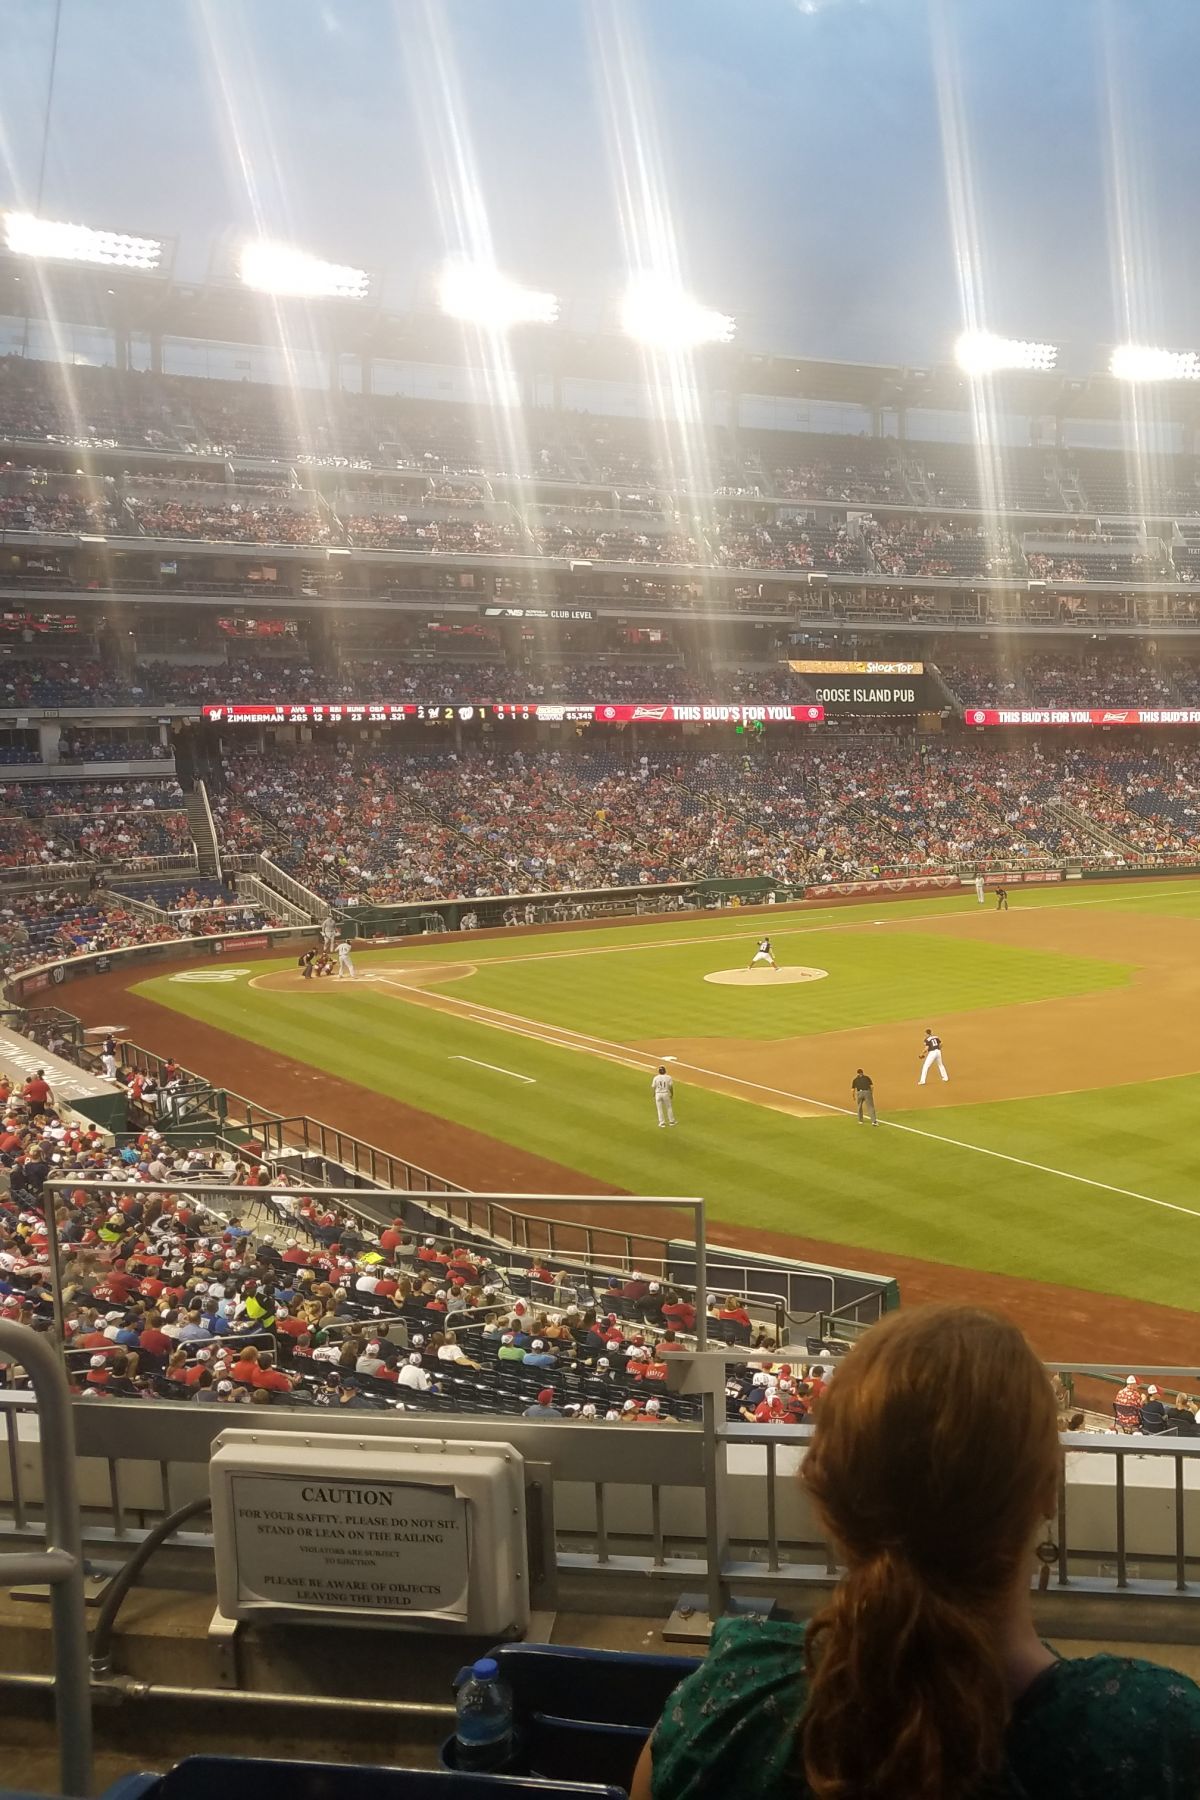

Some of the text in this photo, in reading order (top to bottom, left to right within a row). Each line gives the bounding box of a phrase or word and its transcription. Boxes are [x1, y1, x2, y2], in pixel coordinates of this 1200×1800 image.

[551, 610, 570, 618] CLUB
[572, 611, 593, 620] LEVEL
[816, 689, 915, 703] GOOSE ISLAND PUB
[291, 706, 305, 714] AVG
[418, 710, 425, 719] 2
[445, 709, 454, 719] 2
[480, 708, 486, 719] 1
[673, 707, 701, 720] THIS
[703, 707, 740, 720] BUD'S
[742, 707, 766, 720] FOR
[767, 707, 796, 720] YOU.
[228, 714, 285, 722] ZIMMERMAN
[289, 713, 308, 722] .265
[314, 713, 323, 722] 12
[331, 713, 342, 722] 39
[351, 713, 362, 722] 23
[390, 713, 406, 721] .521
[566, 712, 593, 720] $5,345
[999, 711, 1020, 722] THIS
[1021, 711, 1050, 722] BUD'S
[1051, 711, 1070, 722] FOR
[1070, 711, 1092, 722] YOU.
[1138, 711, 1159, 722] THIS
[1160, 711, 1188, 722] BUD'S
[302, 1487, 394, 1506] CAUTION
[239, 1509, 262, 1519] FOR
[263, 1510, 295, 1521] YOUR
[345, 1515, 388, 1526] PLEASE
[391, 1517, 408, 1528] DO
[411, 1519, 434, 1529] NOT
[257, 1525, 444, 1544] STAND OR LEAN ON THE RAILING
[299, 1545, 345, 1555] VIOLATORS
[364, 1550, 400, 1559] SUBJECT
[264, 1575, 442, 1595] PLEASE BE AWARE OF OBJECTS
[296, 1590, 412, 1606] LEAVING THE FIELD
